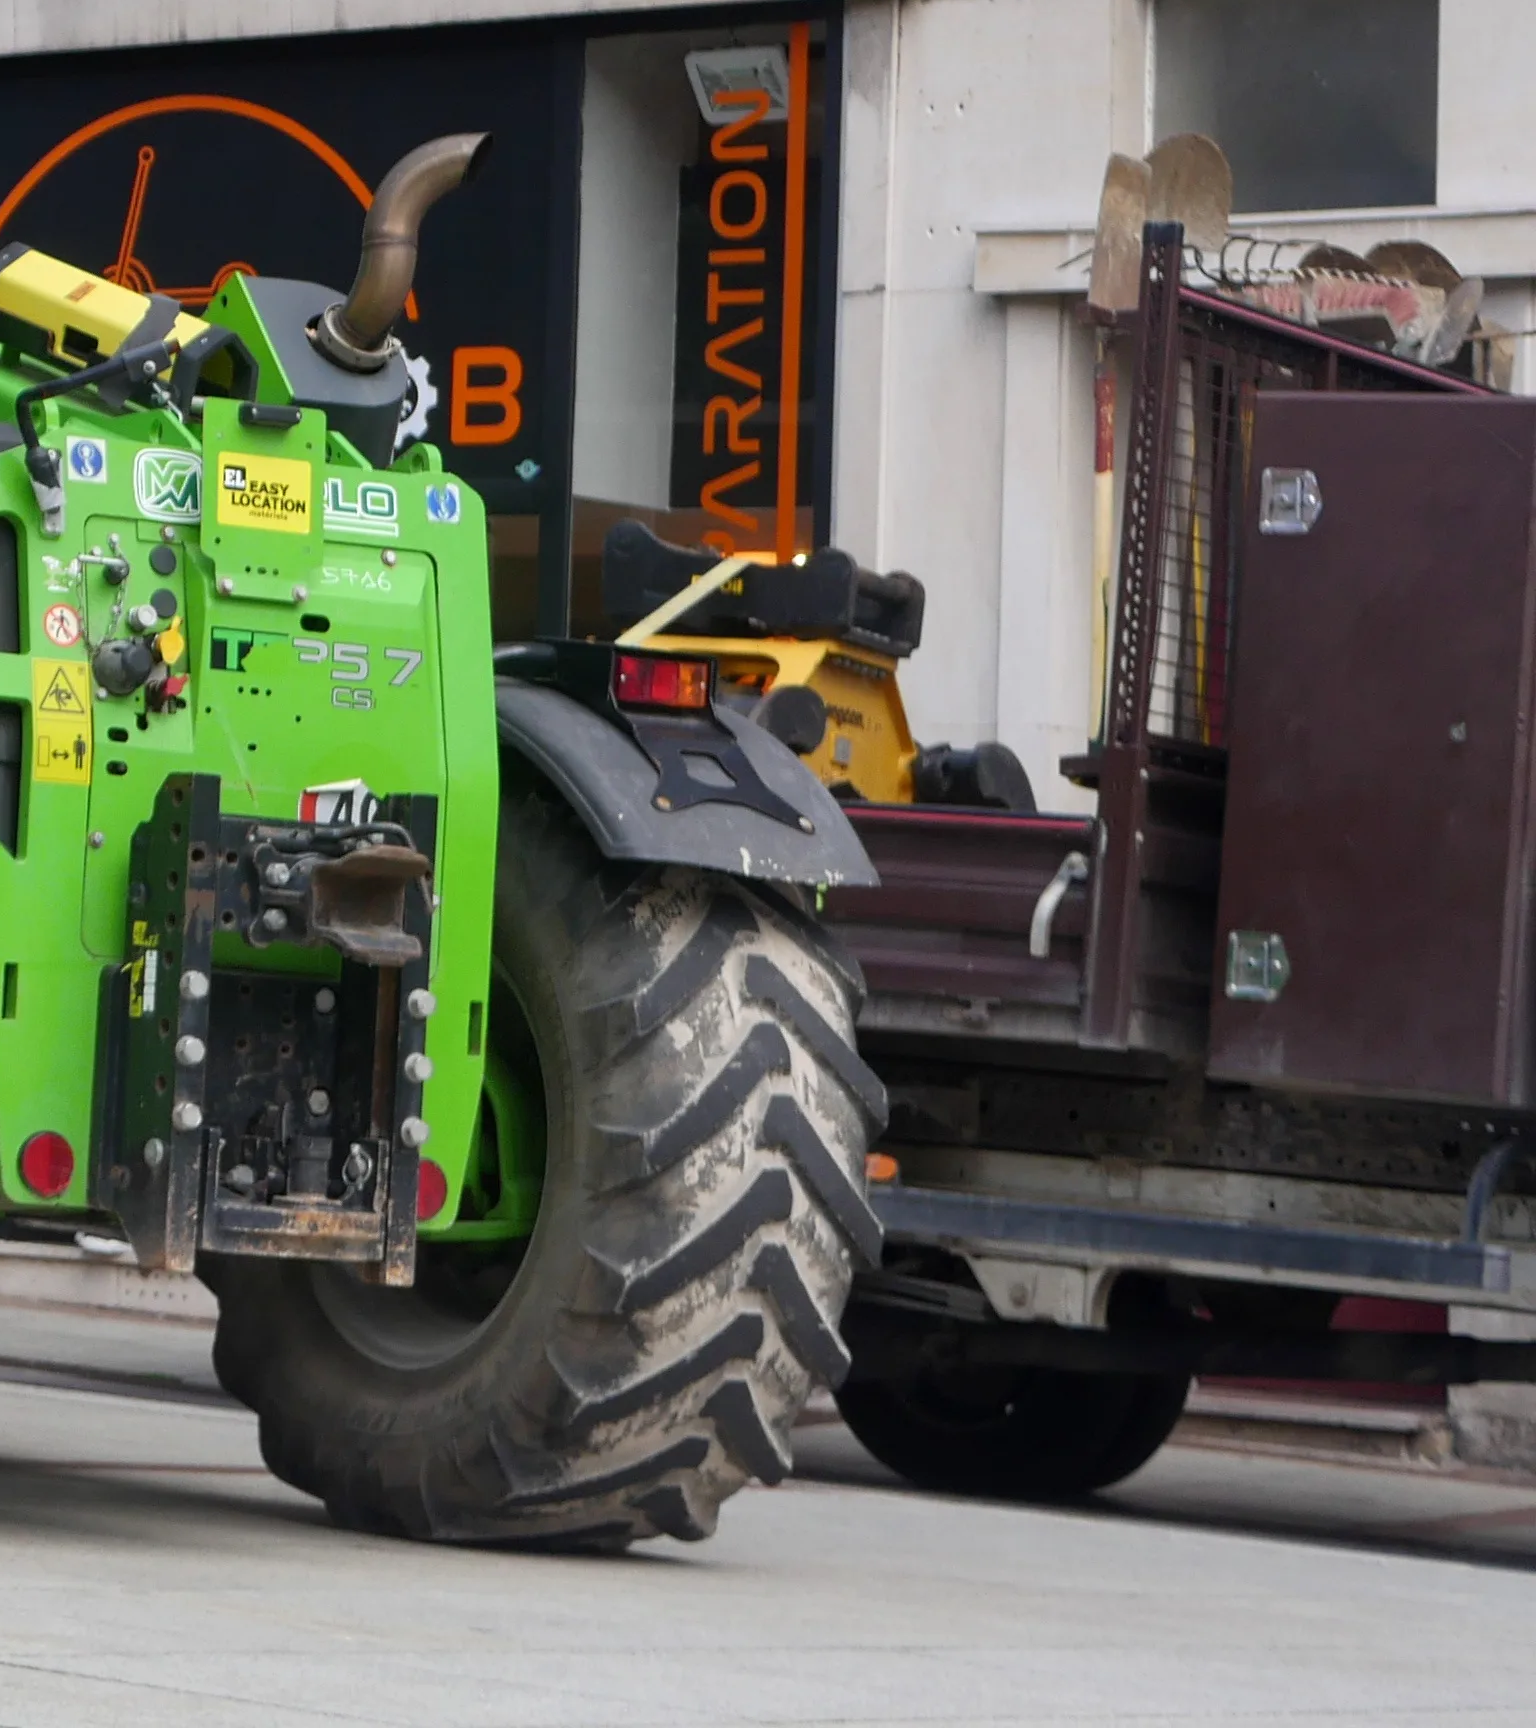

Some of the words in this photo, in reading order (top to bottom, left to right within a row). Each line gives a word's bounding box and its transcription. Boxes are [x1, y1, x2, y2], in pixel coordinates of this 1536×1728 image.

[224, 466, 246, 488] EL
[249, 480, 289, 496] EASY
[231, 491, 306, 514] LOCATION
